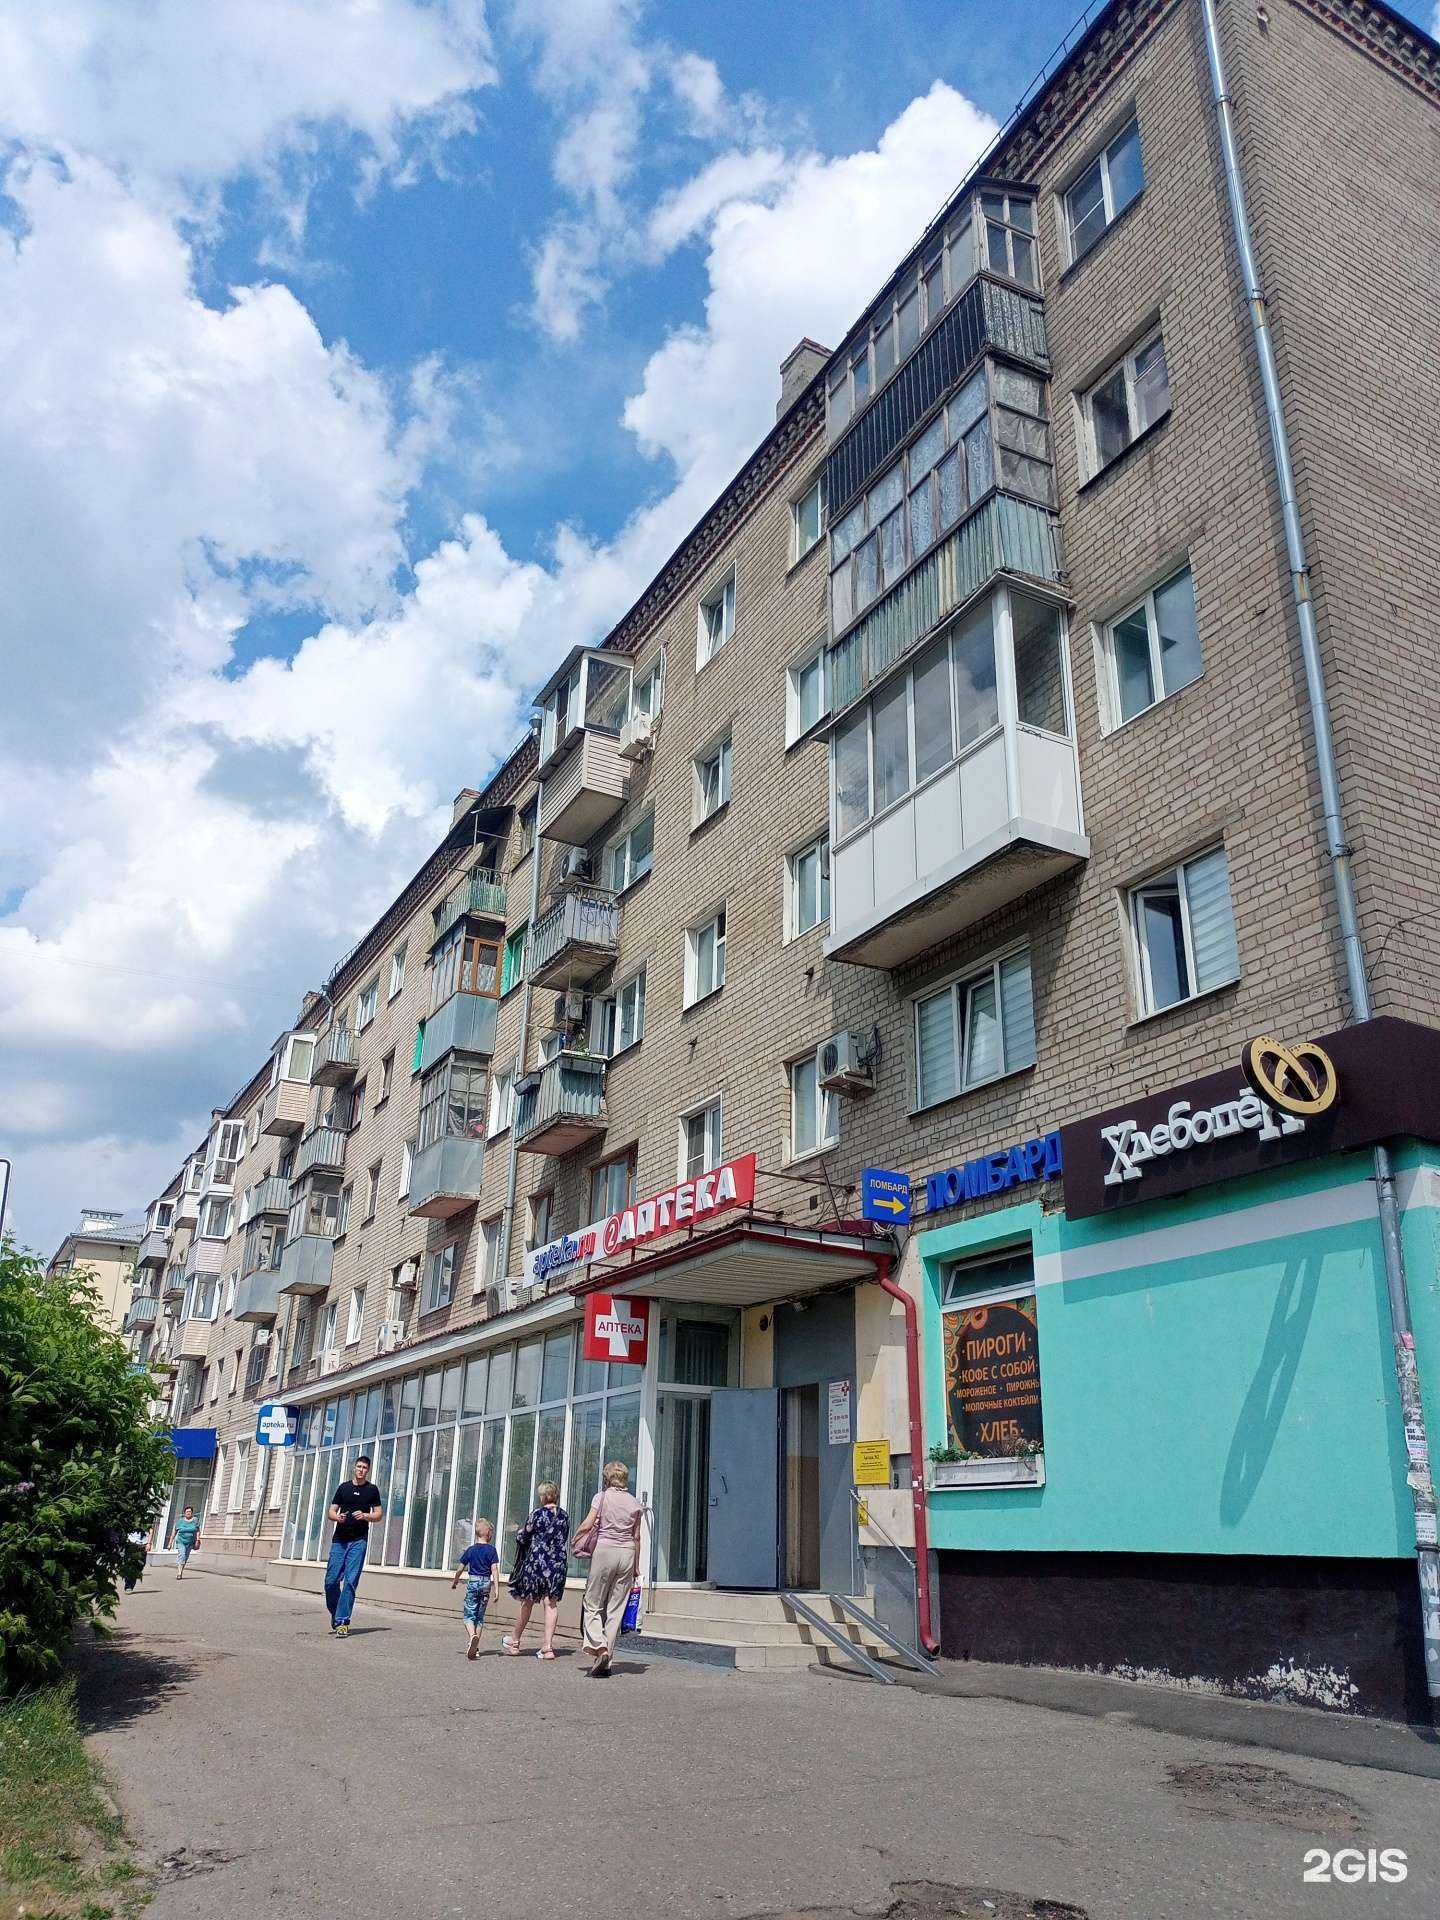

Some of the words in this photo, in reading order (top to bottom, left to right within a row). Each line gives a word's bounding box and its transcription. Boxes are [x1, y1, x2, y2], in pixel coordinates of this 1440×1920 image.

[926, 1131, 1063, 1212] ЛОМБАРД
[870, 1179, 908, 1195] ЛОМБАРД
[617, 1167, 737, 1245] АПТЕКА
[598, 1321, 642, 1335] АПТЕКА
[966, 1331, 1026, 1361] ПИРОГИ
[961, 1366, 989, 1383] КОФЕ
[991, 1365, 998, 1379] С
[1000, 1355, 1036, 1378] СОБОЙ
[979, 1419, 1019, 1442] ХЛЕБ
